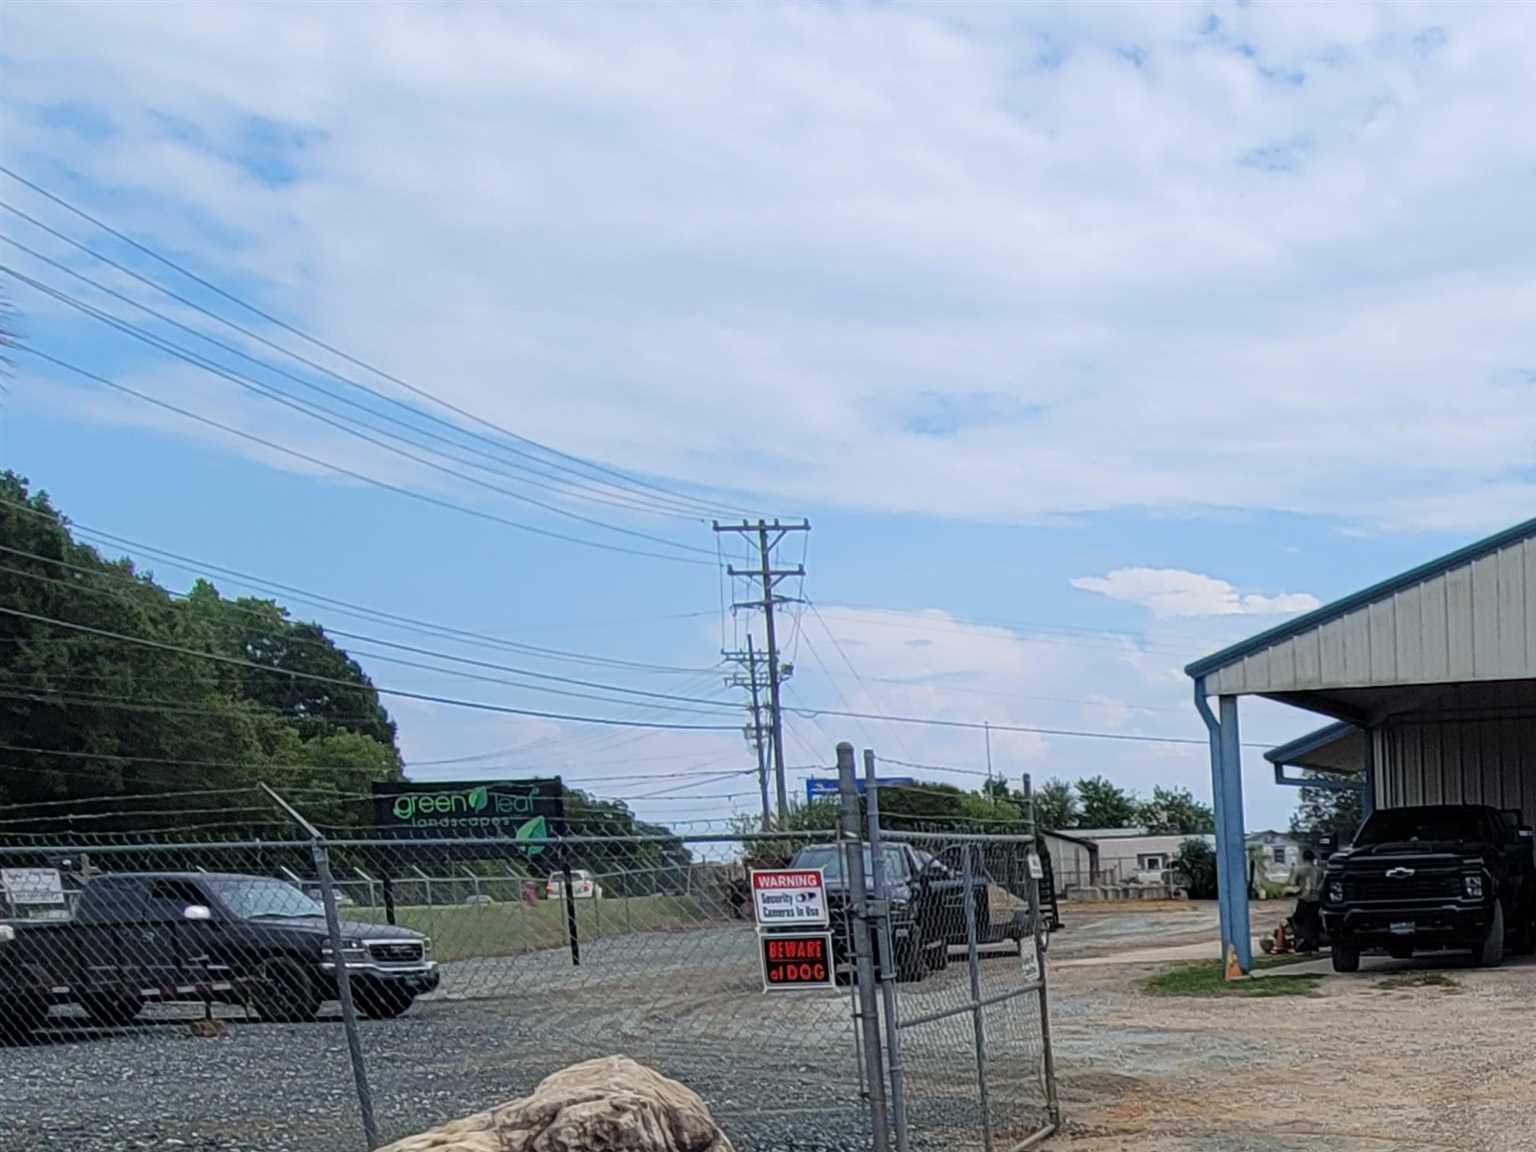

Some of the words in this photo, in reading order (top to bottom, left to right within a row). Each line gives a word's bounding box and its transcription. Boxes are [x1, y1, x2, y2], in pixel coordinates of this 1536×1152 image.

[393, 795, 468, 819] green
[495, 788, 540, 813] leaf
[412, 817, 509, 828] landscapes
[759, 875, 817, 887] WARNING
[761, 892, 793, 905] Security
[763, 906, 795, 918] Cameras
[796, 906, 804, 916] In
[806, 905, 819, 916] Use
[769, 941, 821, 957] BEWARE
[786, 963, 825, 980] DOG
